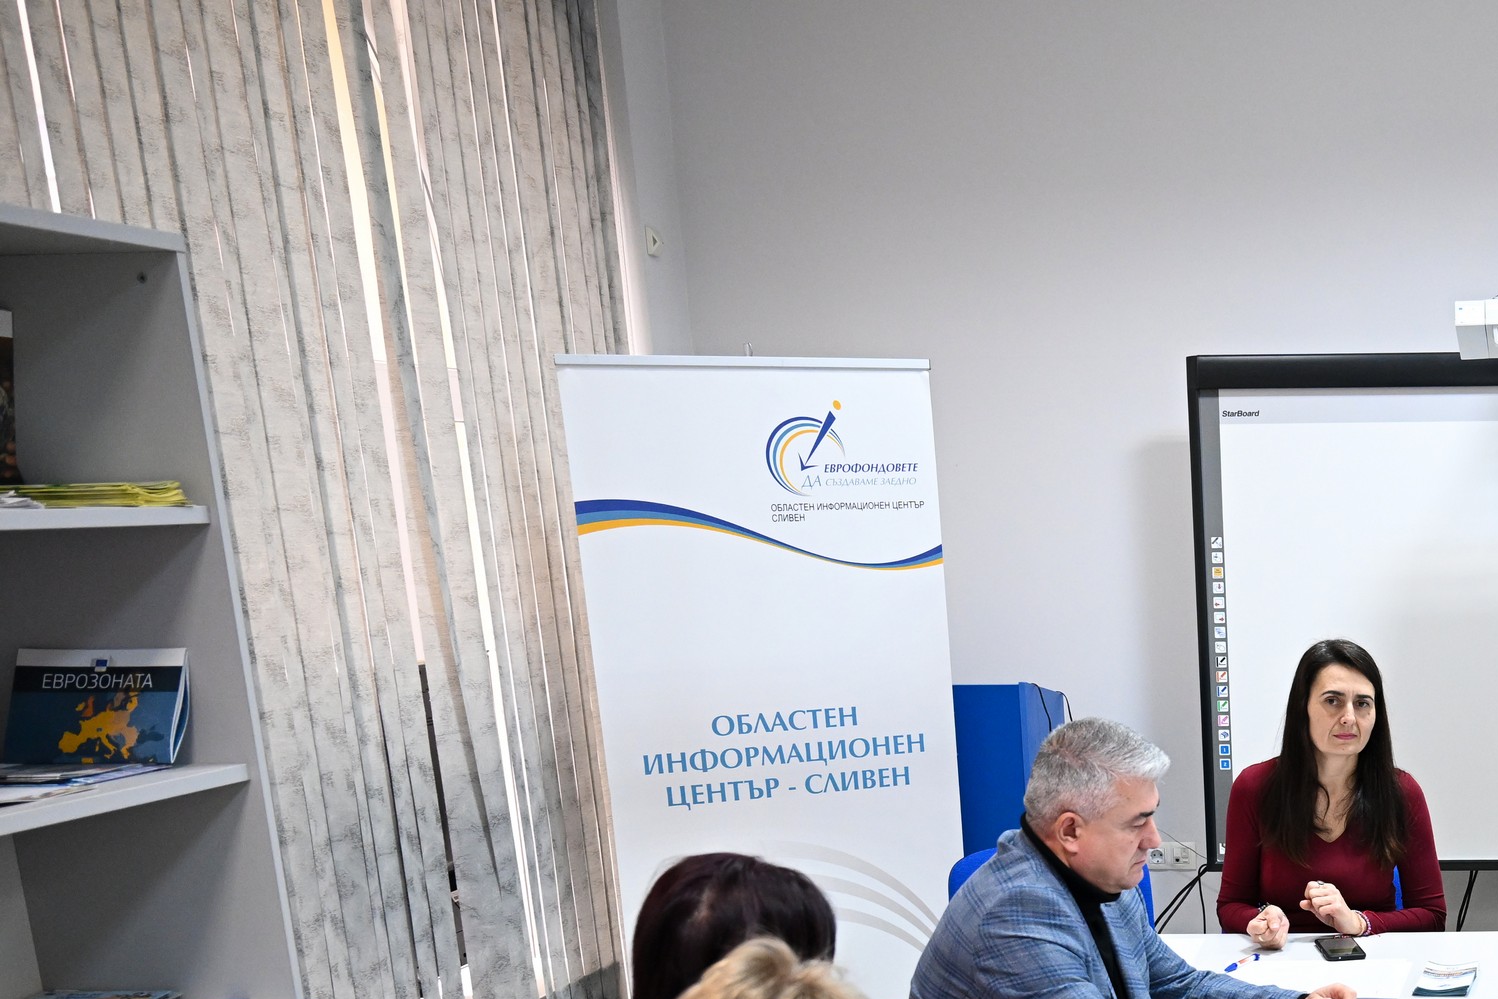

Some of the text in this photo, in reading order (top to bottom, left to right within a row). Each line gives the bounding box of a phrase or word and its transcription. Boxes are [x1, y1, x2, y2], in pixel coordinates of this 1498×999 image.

[1221, 409, 1260, 418] StarBoard
[824, 462, 919, 474] ЕВРОФОНДОВЕТЕ
[801, 474, 917, 489] ДА СЪЗДАВАМЕ ЗАЕДНО
[770, 500, 925, 513] ОБЛАСТЕН ИНФОРМАЦИОНЕН ЦЕНТЪР
[771, 513, 806, 522] СЛИВЕН
[41, 673, 153, 689] ЕВРОЗОНАТА
[711, 706, 858, 737] ОБЛАСТЕН
[643, 733, 926, 776] ИНФОРМАЦИОНЕН
[665, 777, 780, 811] ЦЕНТЪР
[804, 766, 911, 795] СЛИВЕН
